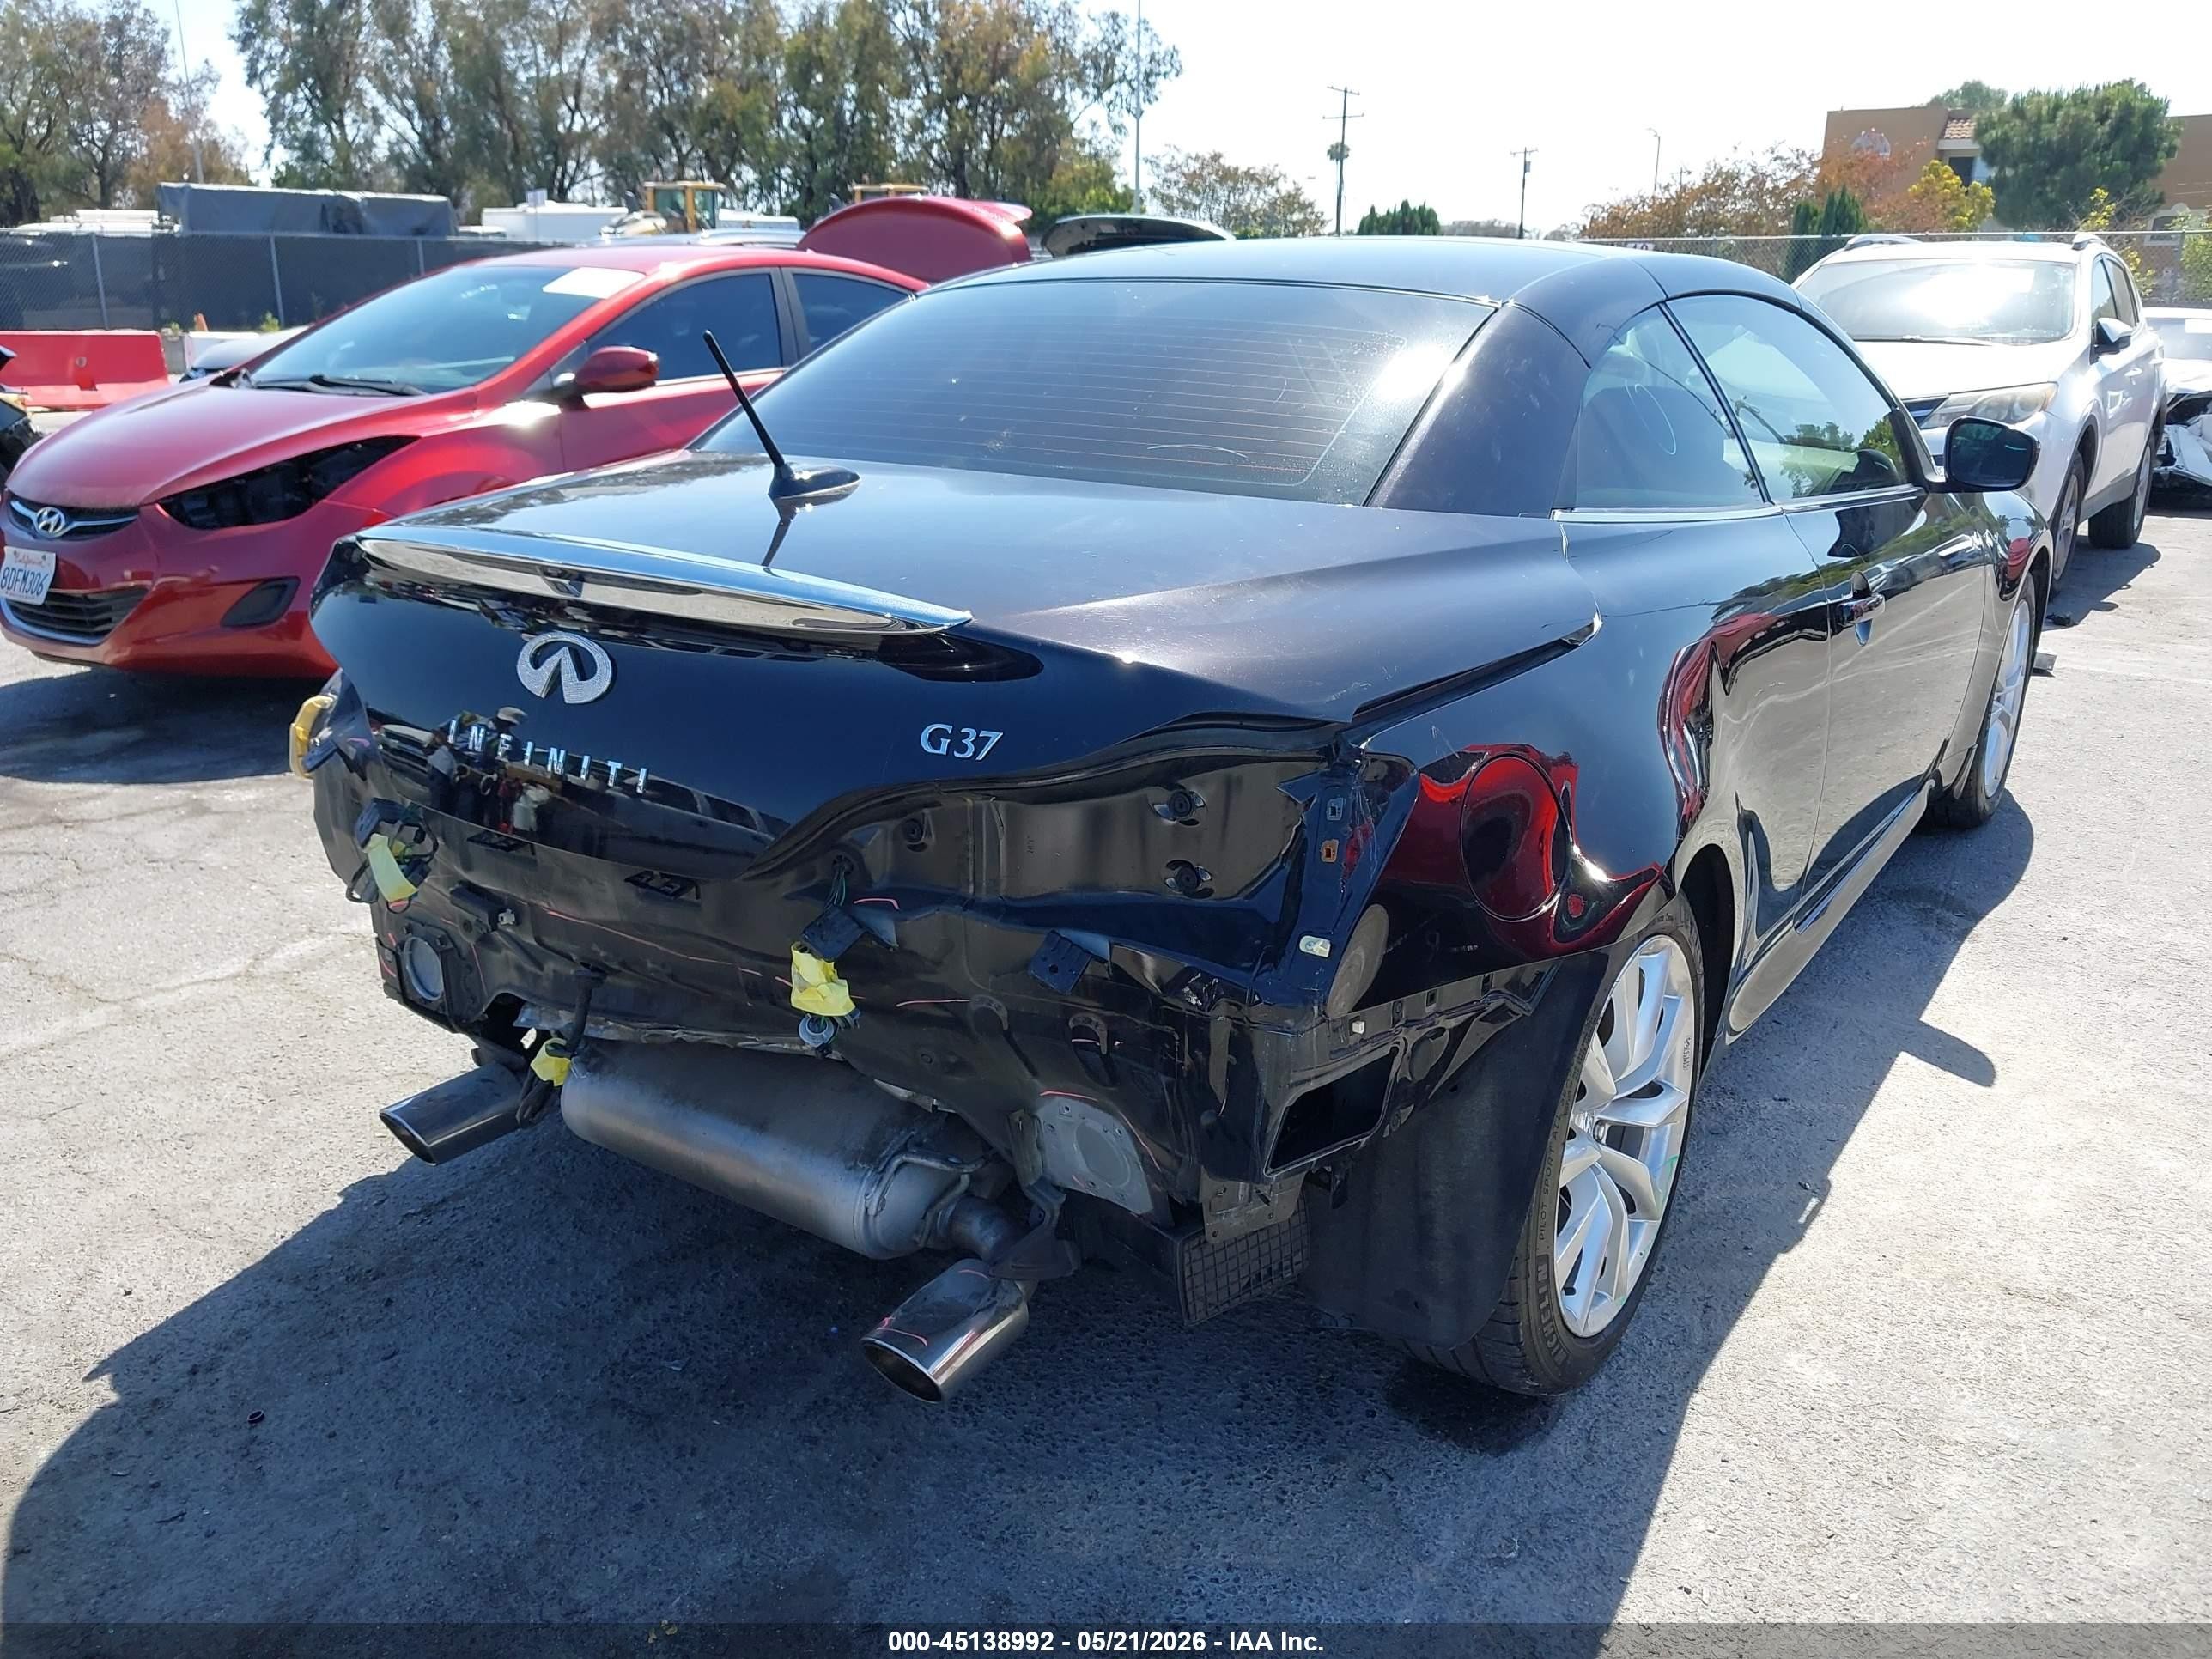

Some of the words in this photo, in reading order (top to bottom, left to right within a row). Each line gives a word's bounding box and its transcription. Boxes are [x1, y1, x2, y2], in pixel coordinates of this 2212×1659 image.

[1, 567, 49, 597] 8DFM306
[447, 720, 648, 794] INFINITI
[920, 723, 1003, 761] G37
[1539, 1204, 1548, 1240] PILOT
[1544, 1148, 1555, 1194] SPORT
[1537, 1263, 1567, 1366] MICHELIN
